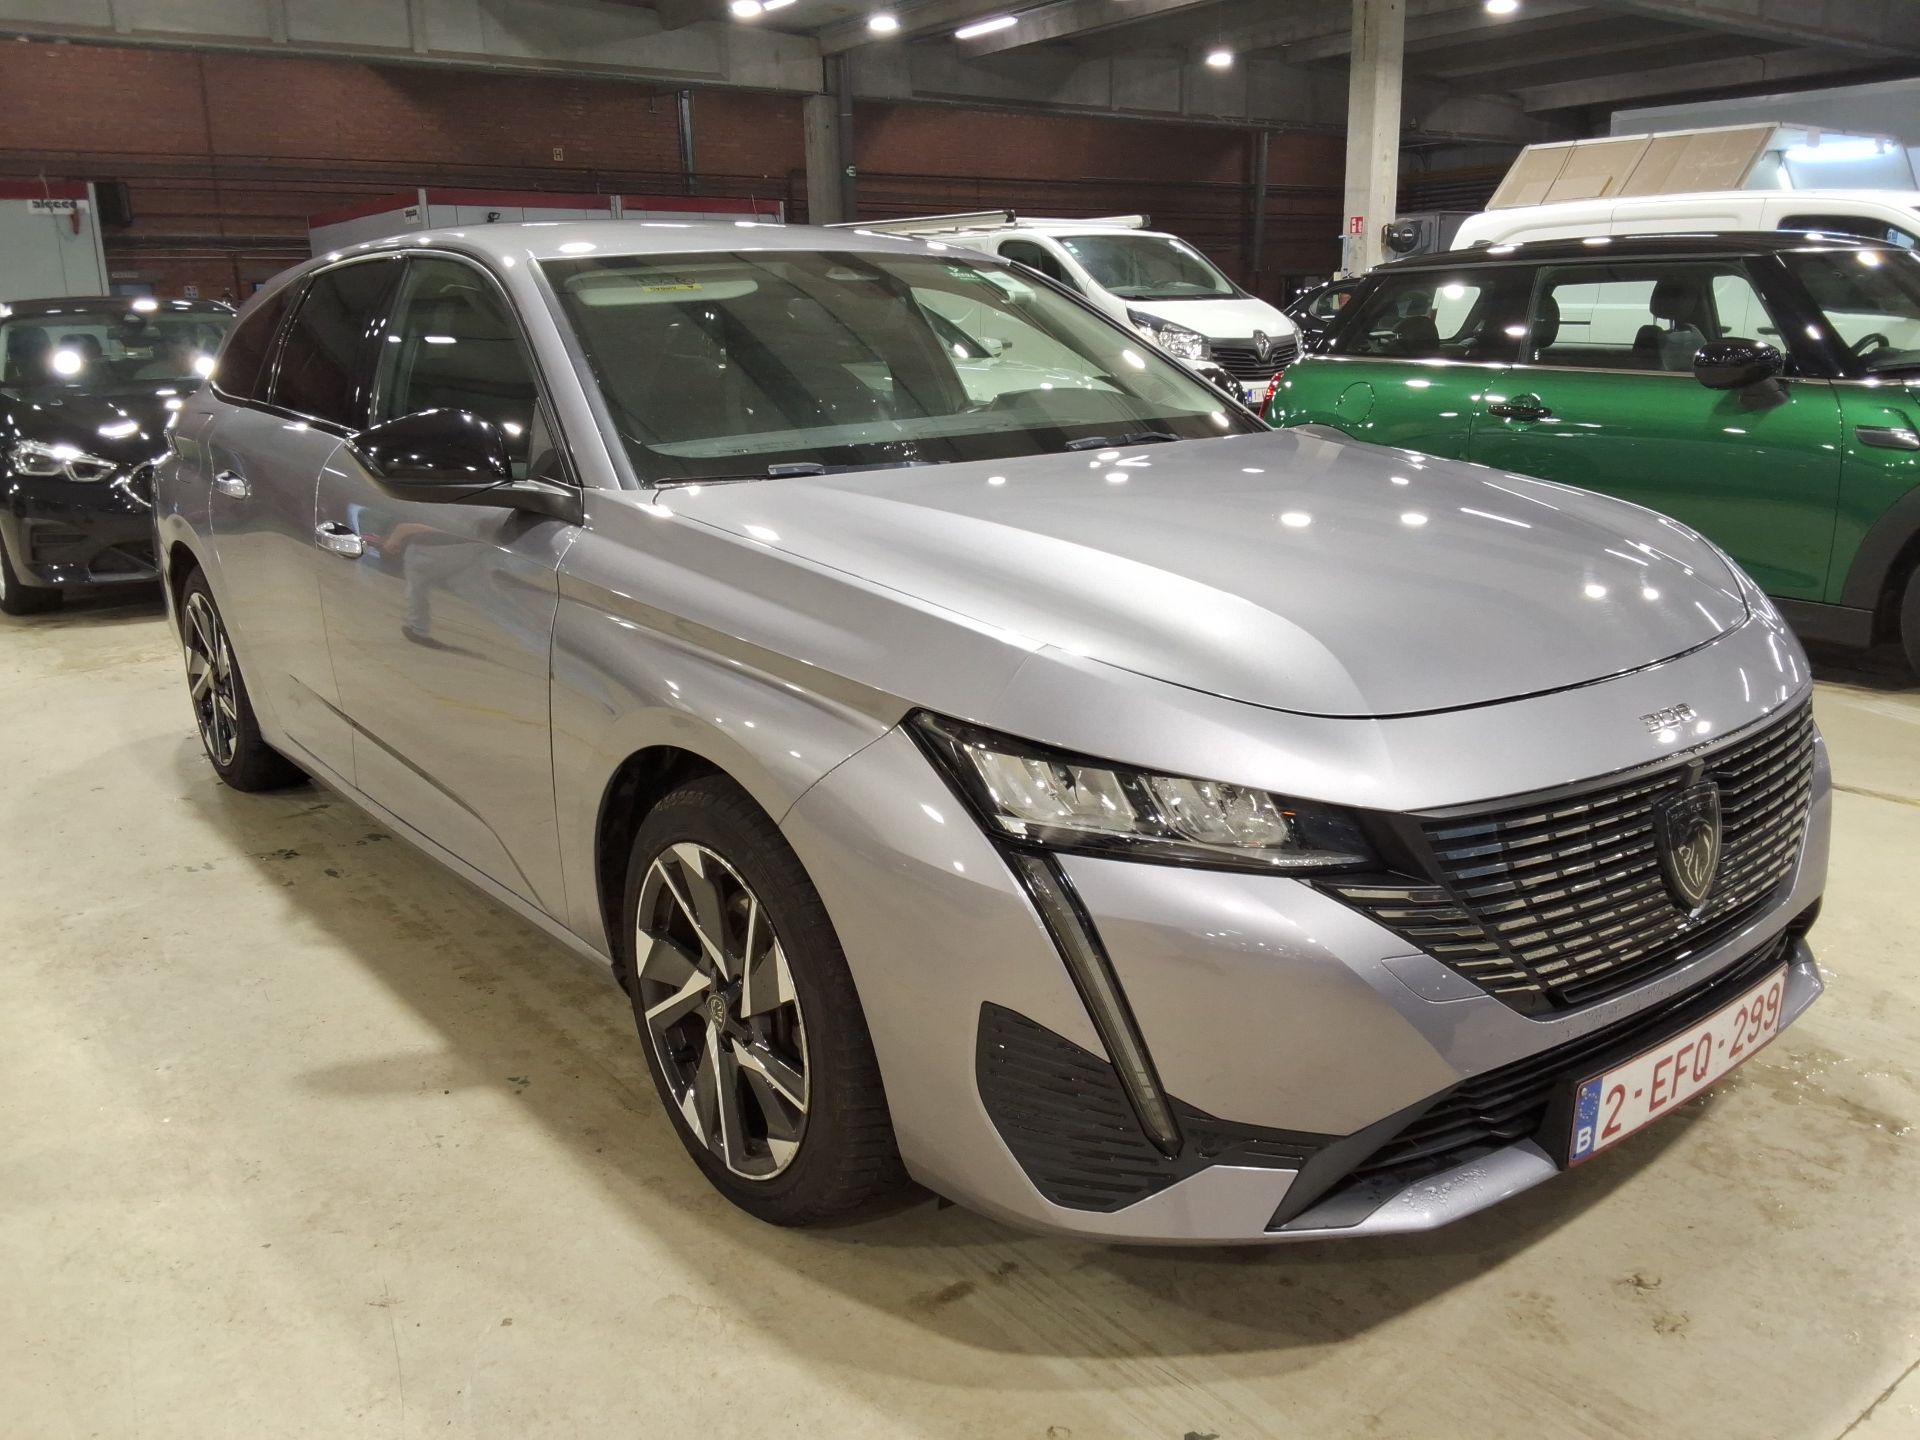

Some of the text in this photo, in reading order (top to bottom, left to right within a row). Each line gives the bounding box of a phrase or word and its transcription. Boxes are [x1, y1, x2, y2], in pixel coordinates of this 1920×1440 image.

[1639, 702, 1697, 733] 308
[1601, 982, 1780, 1140] 2-EFQ-299
[1576, 1126, 1592, 1154] B
